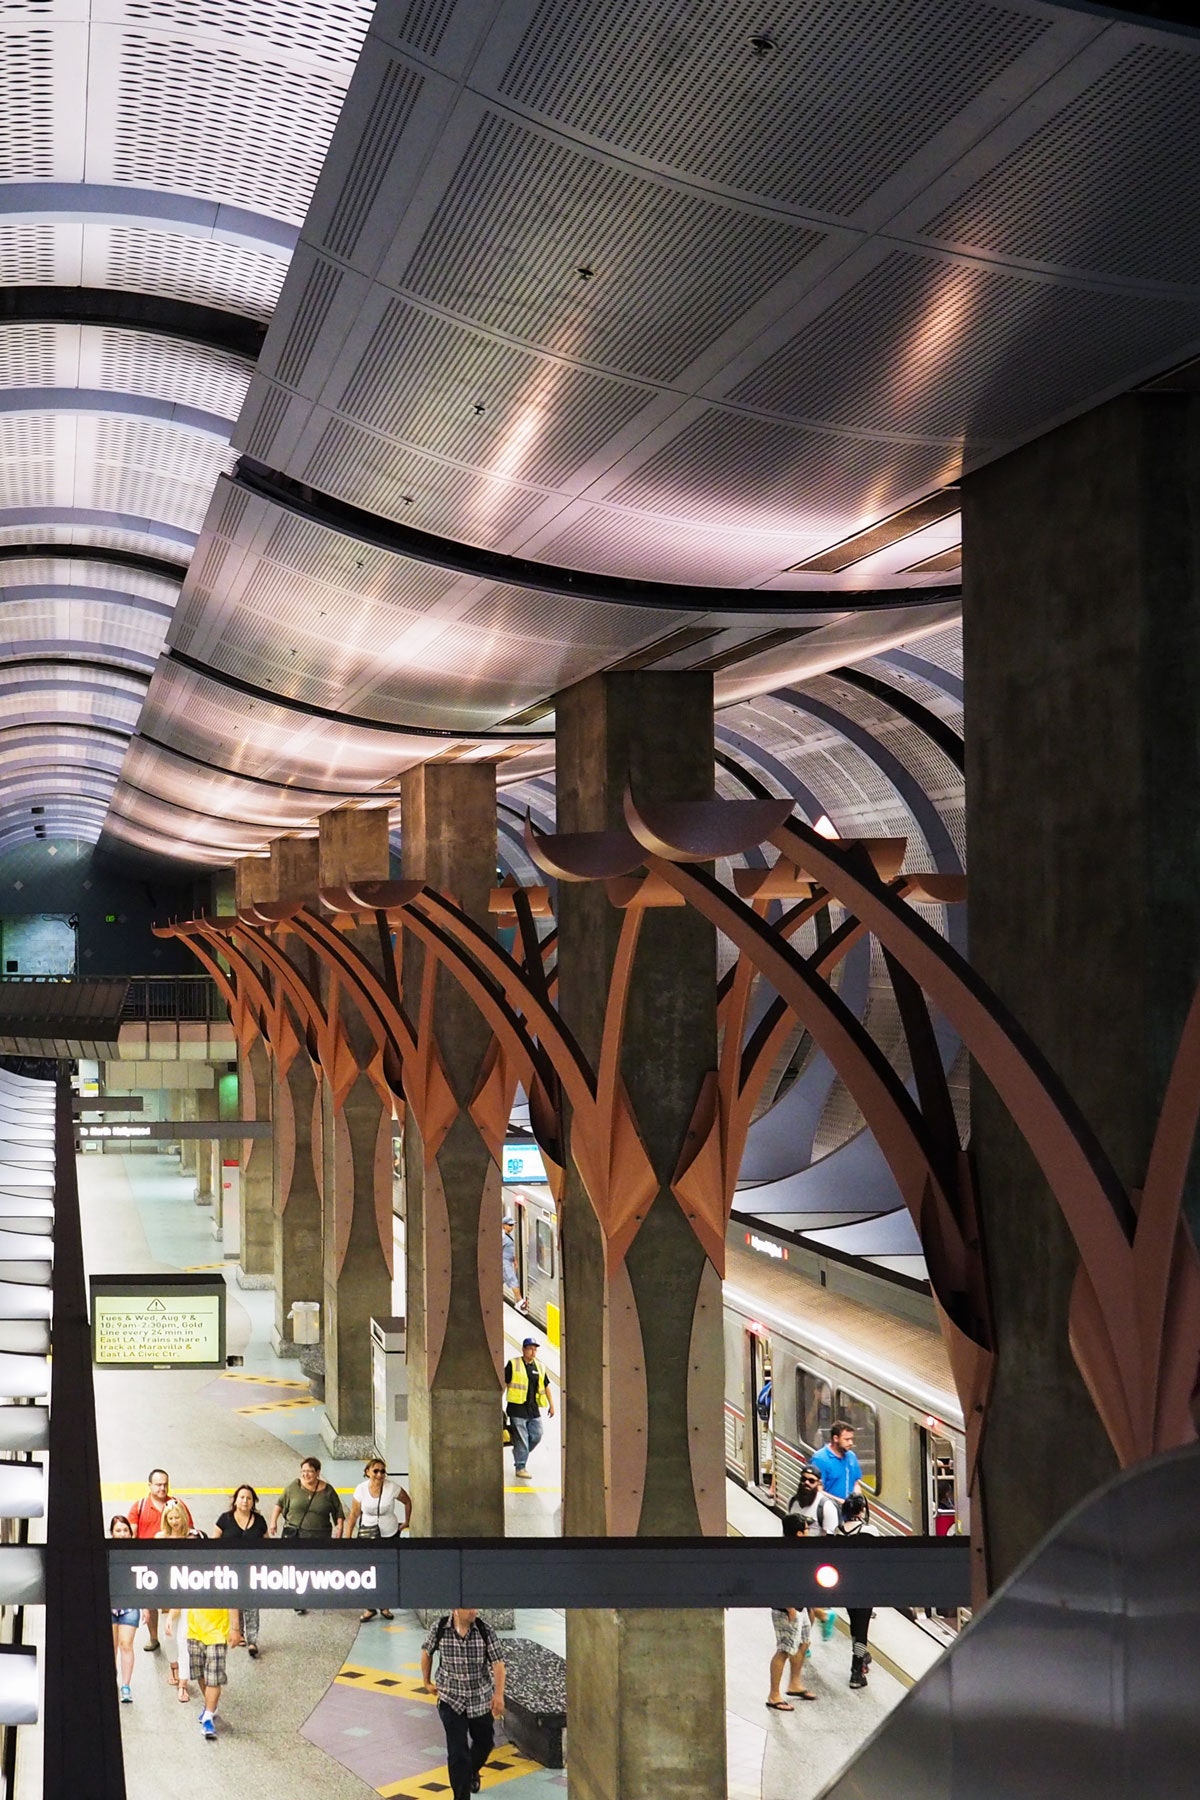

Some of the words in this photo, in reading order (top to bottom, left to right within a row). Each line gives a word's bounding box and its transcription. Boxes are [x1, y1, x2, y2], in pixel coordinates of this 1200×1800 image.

[131, 1565, 159, 1590] To
[170, 1565, 239, 1590] North
[250, 1565, 377, 1595] Hollywood
